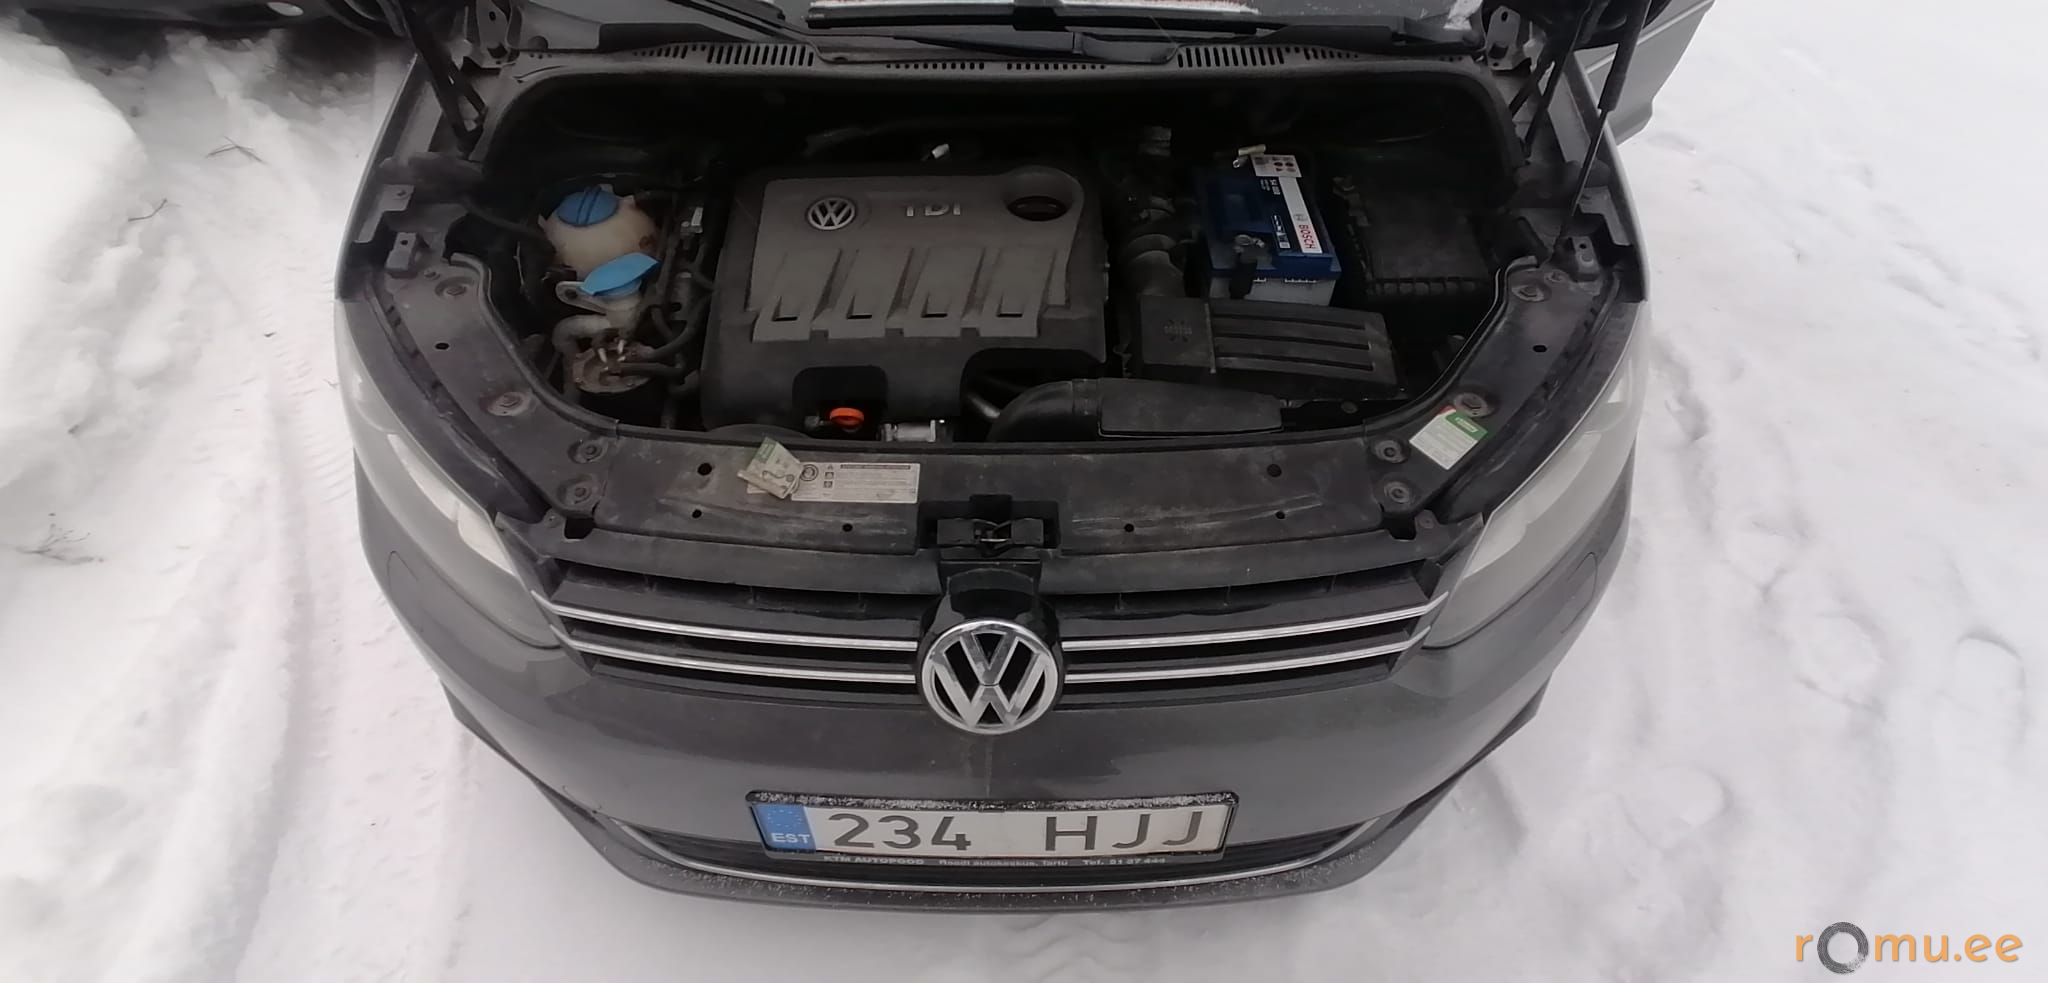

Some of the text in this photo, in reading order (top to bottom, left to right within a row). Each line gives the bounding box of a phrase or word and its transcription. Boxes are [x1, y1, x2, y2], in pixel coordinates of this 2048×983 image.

[905, 202, 961, 217] TDI
[1298, 224, 1316, 249] BOSCH
[921, 618, 1060, 735] VW
[771, 831, 811, 845] EST
[828, 810, 1204, 851] 234 HJJ
